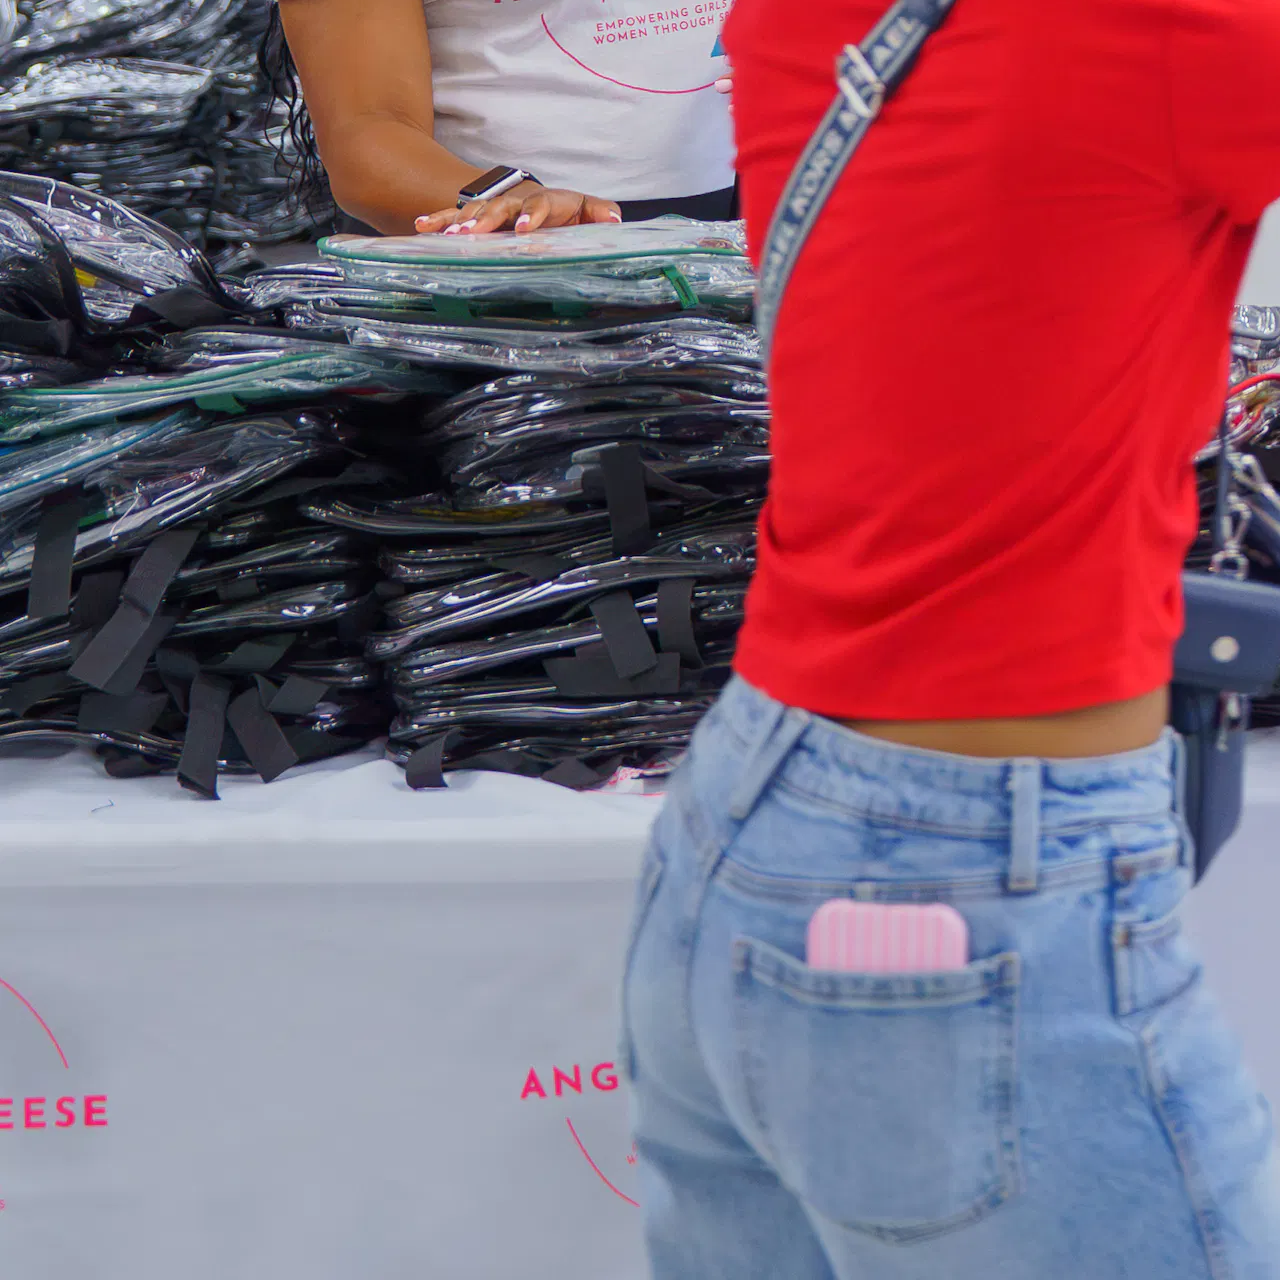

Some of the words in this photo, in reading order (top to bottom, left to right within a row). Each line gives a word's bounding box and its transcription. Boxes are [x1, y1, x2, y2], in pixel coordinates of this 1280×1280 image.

[593, 28, 648, 45] WOMEN
[653, 15, 715, 35] THROUGH
[596, 7, 689, 32] EMPOWERING
[694, 0, 727, 14] GIRLS
